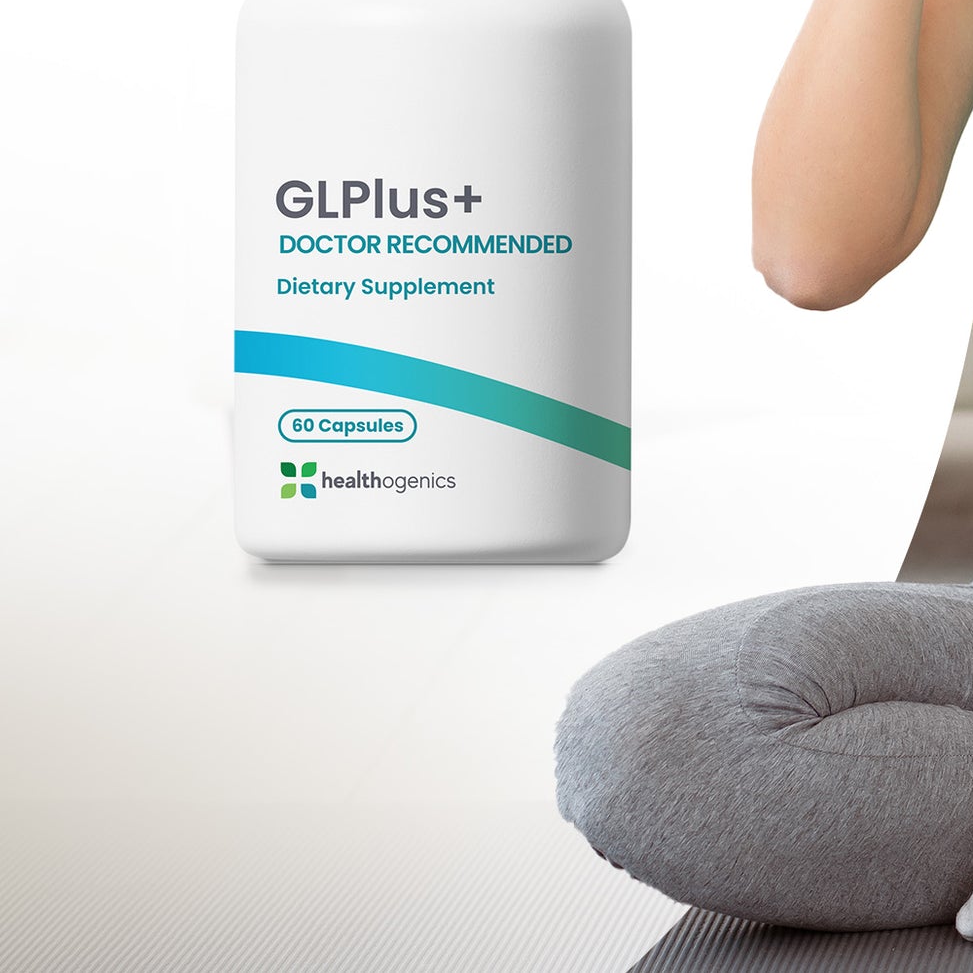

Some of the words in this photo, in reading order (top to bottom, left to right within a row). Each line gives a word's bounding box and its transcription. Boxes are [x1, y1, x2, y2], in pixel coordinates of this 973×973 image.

[275, 178, 482, 219] GLPlus+
[279, 234, 382, 255] DOCTOR
[386, 234, 573, 255] RECOMMENDED
[277, 276, 357, 301] Dietary
[361, 277, 496, 301] Supplement
[292, 417, 315, 434] 60
[318, 417, 405, 438] Capsules
[321, 469, 457, 495] healthogenics
